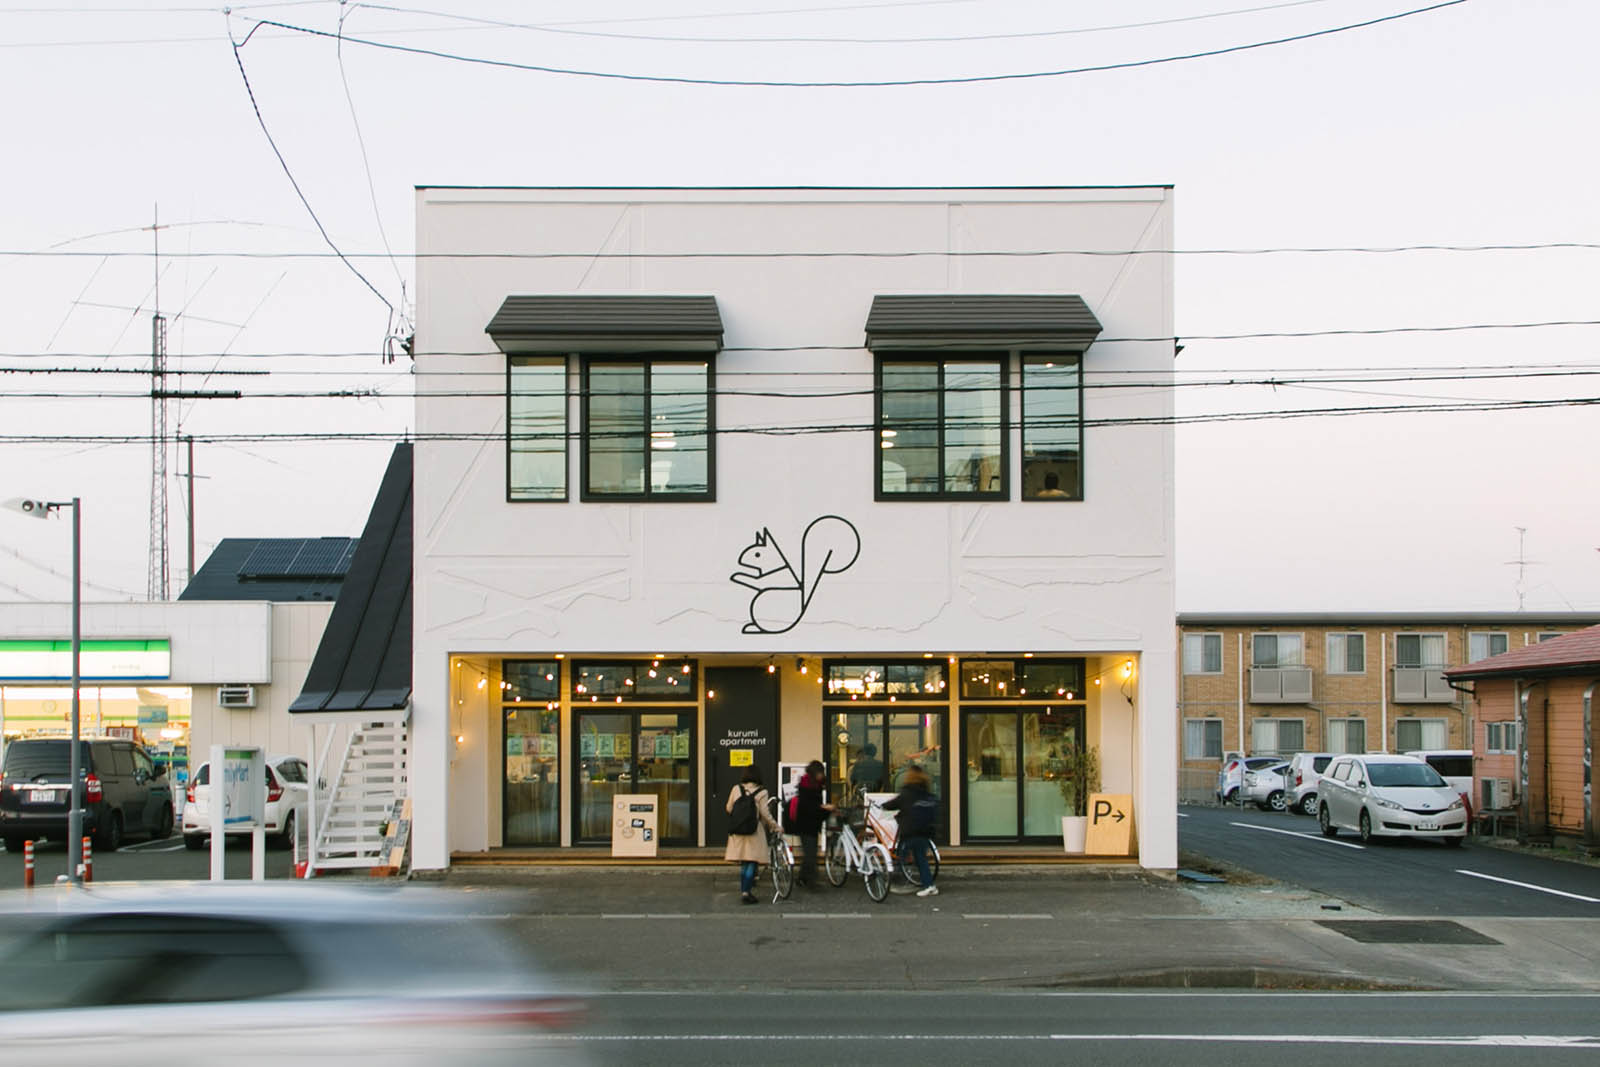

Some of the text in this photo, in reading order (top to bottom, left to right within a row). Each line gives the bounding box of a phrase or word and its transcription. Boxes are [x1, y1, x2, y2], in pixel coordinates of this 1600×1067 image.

[728, 729, 758, 737] kurumi
[720, 738, 766, 746] apartment
[1094, 800, 1112, 824] P
